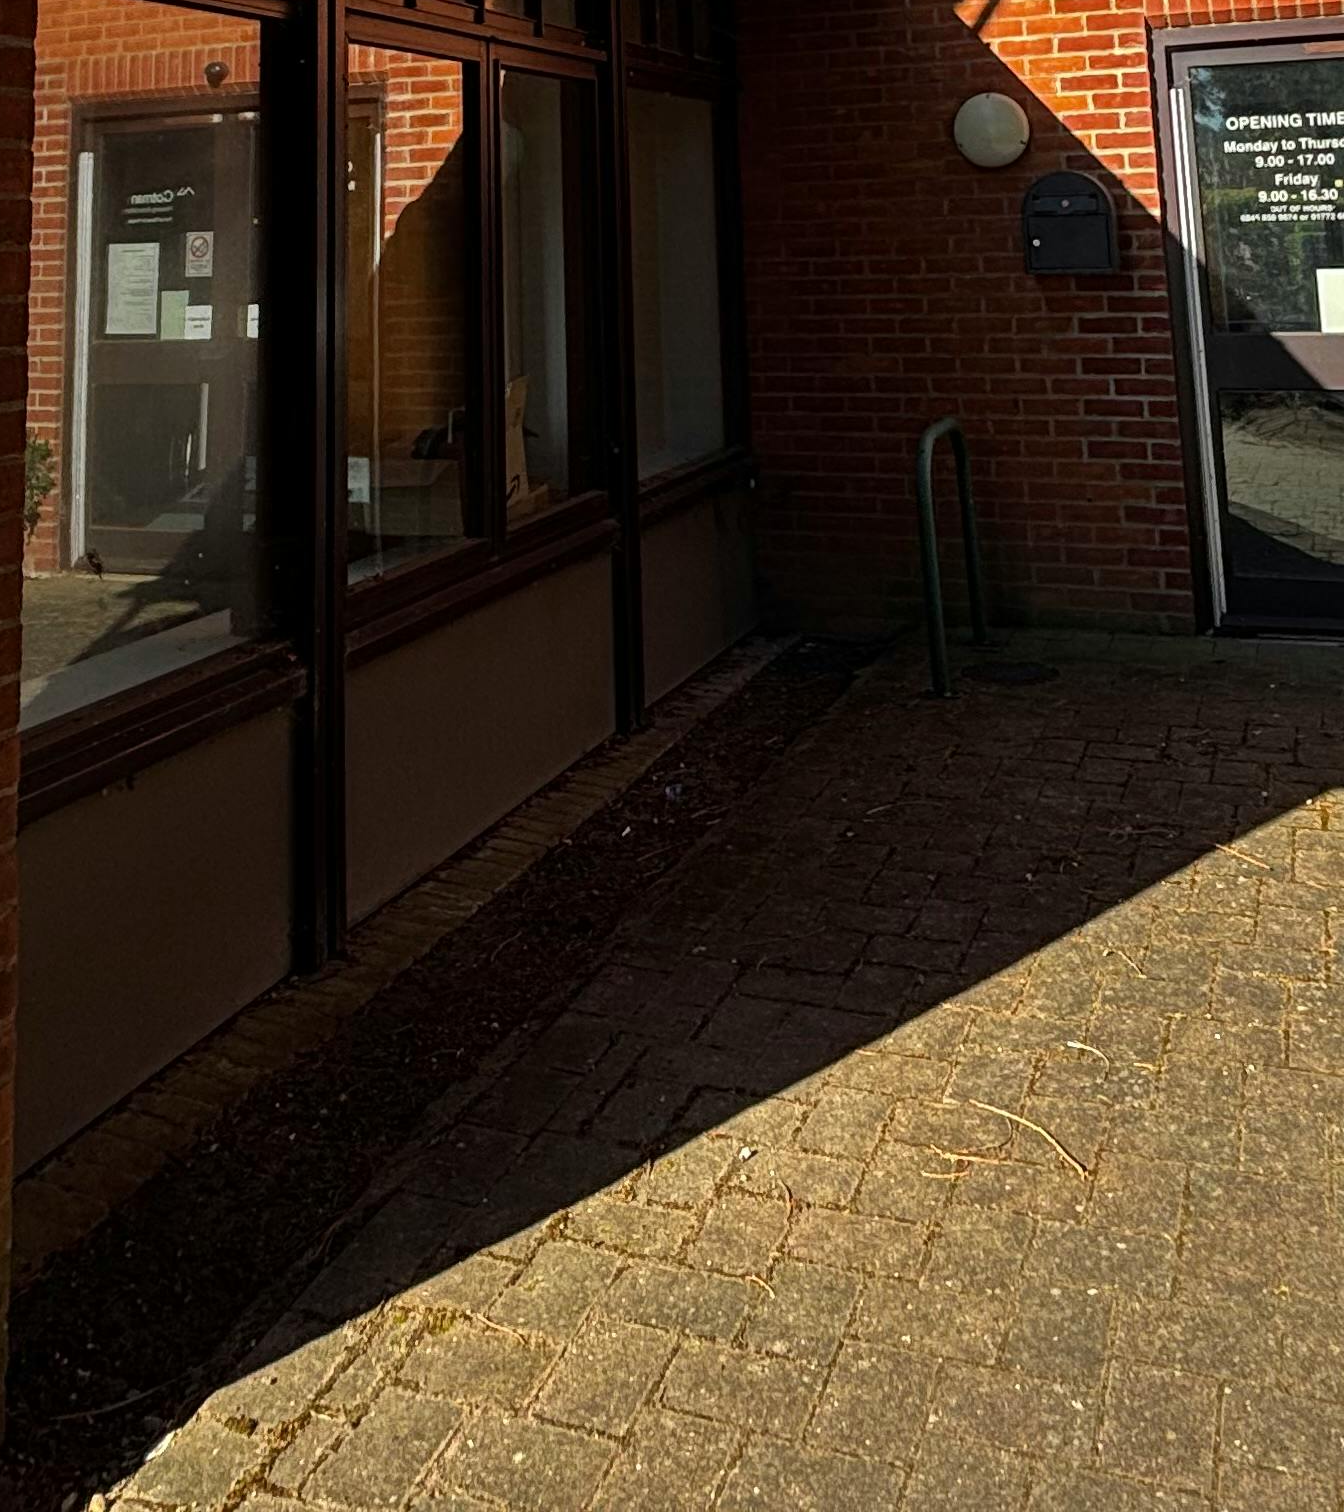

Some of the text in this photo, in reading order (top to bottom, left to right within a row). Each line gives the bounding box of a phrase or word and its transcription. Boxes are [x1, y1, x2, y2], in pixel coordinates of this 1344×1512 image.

[1225, 113, 1303, 131] OPENING
[1223, 139, 1278, 154] Monday
[1281, 138, 1296, 151] to
[1254, 155, 1285, 168] 9.00
[1297, 153, 1336, 166] 17.00
[1274, 173, 1319, 188] Friday
[1257, 190, 1289, 203] 9.00
[1300, 189, 1339, 202] 16.30
